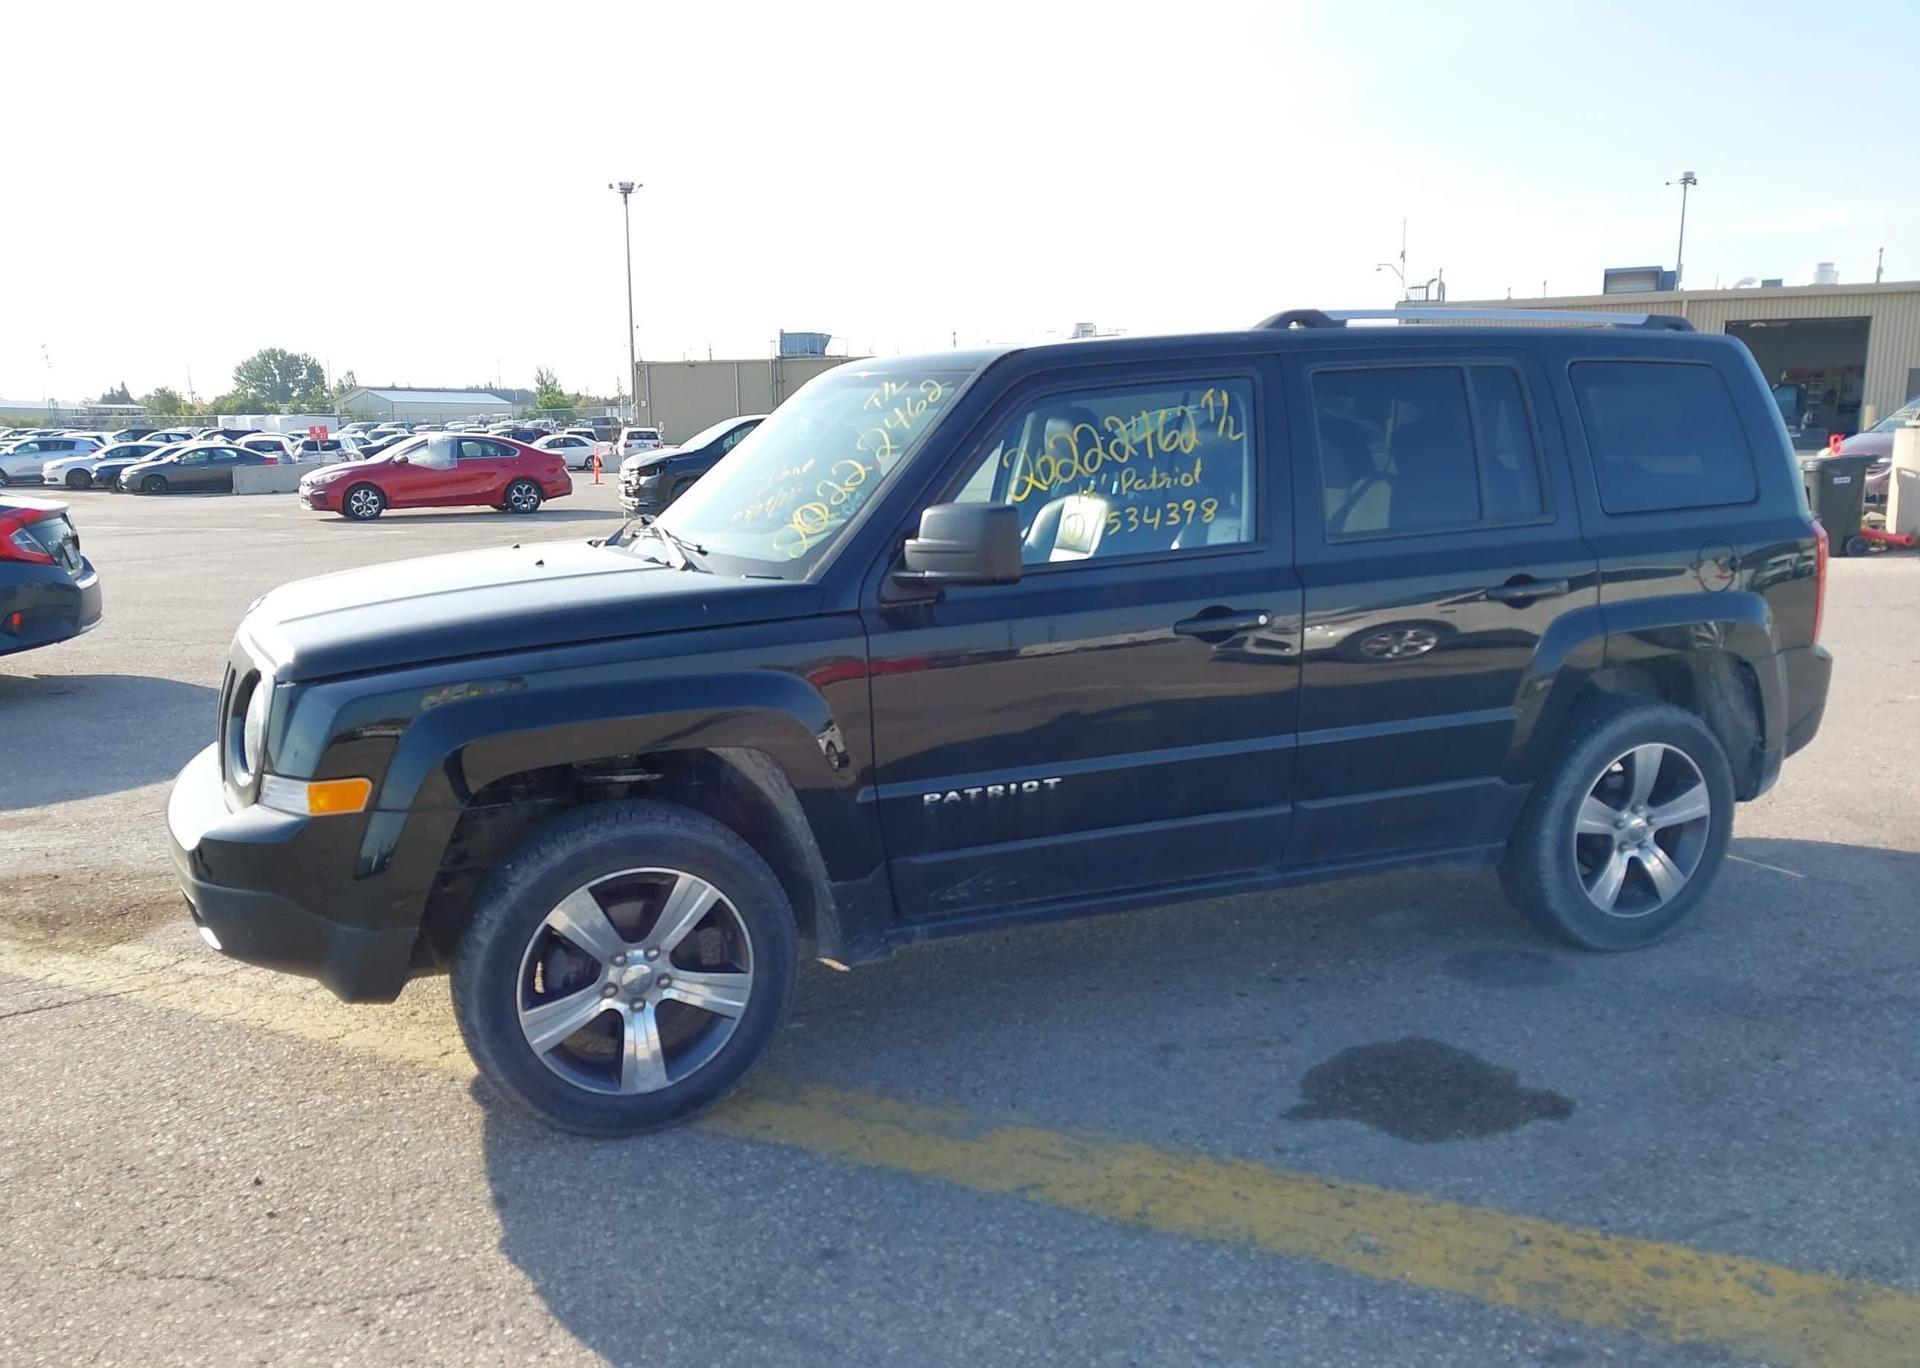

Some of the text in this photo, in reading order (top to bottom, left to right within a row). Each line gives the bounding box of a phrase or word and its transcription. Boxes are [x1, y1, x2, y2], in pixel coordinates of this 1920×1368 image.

[773, 379, 954, 559] 20222462
[1003, 404, 1202, 502] 20222462
[1120, 457, 1202, 496] Patriot
[1106, 497, 1218, 536] 534398
[922, 777, 1063, 806] PATRIOT
